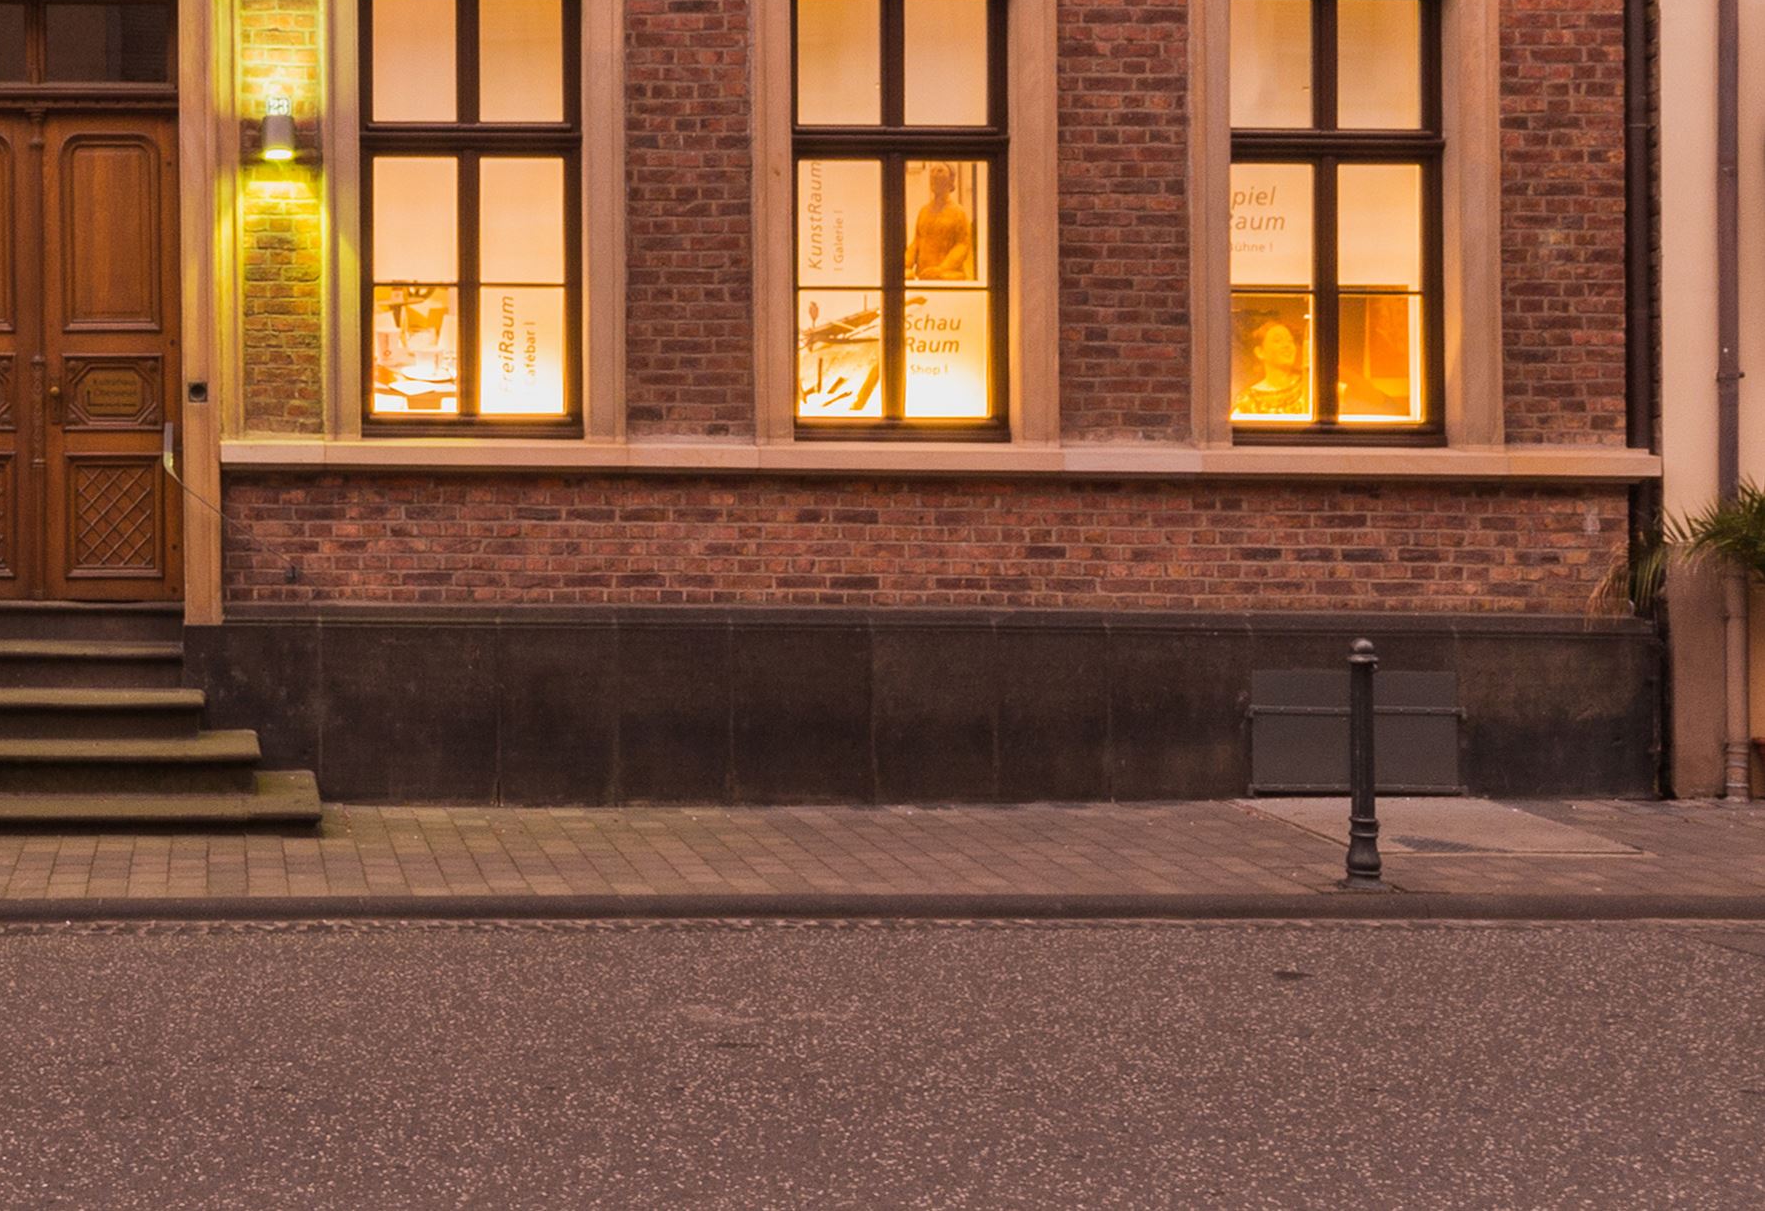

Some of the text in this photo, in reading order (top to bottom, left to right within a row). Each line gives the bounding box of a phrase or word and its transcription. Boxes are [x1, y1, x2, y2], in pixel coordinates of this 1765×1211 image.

[1231, 186, 1277, 210] piel
[808, 162, 823, 270] KunstRaum
[905, 337, 961, 353] Raum
